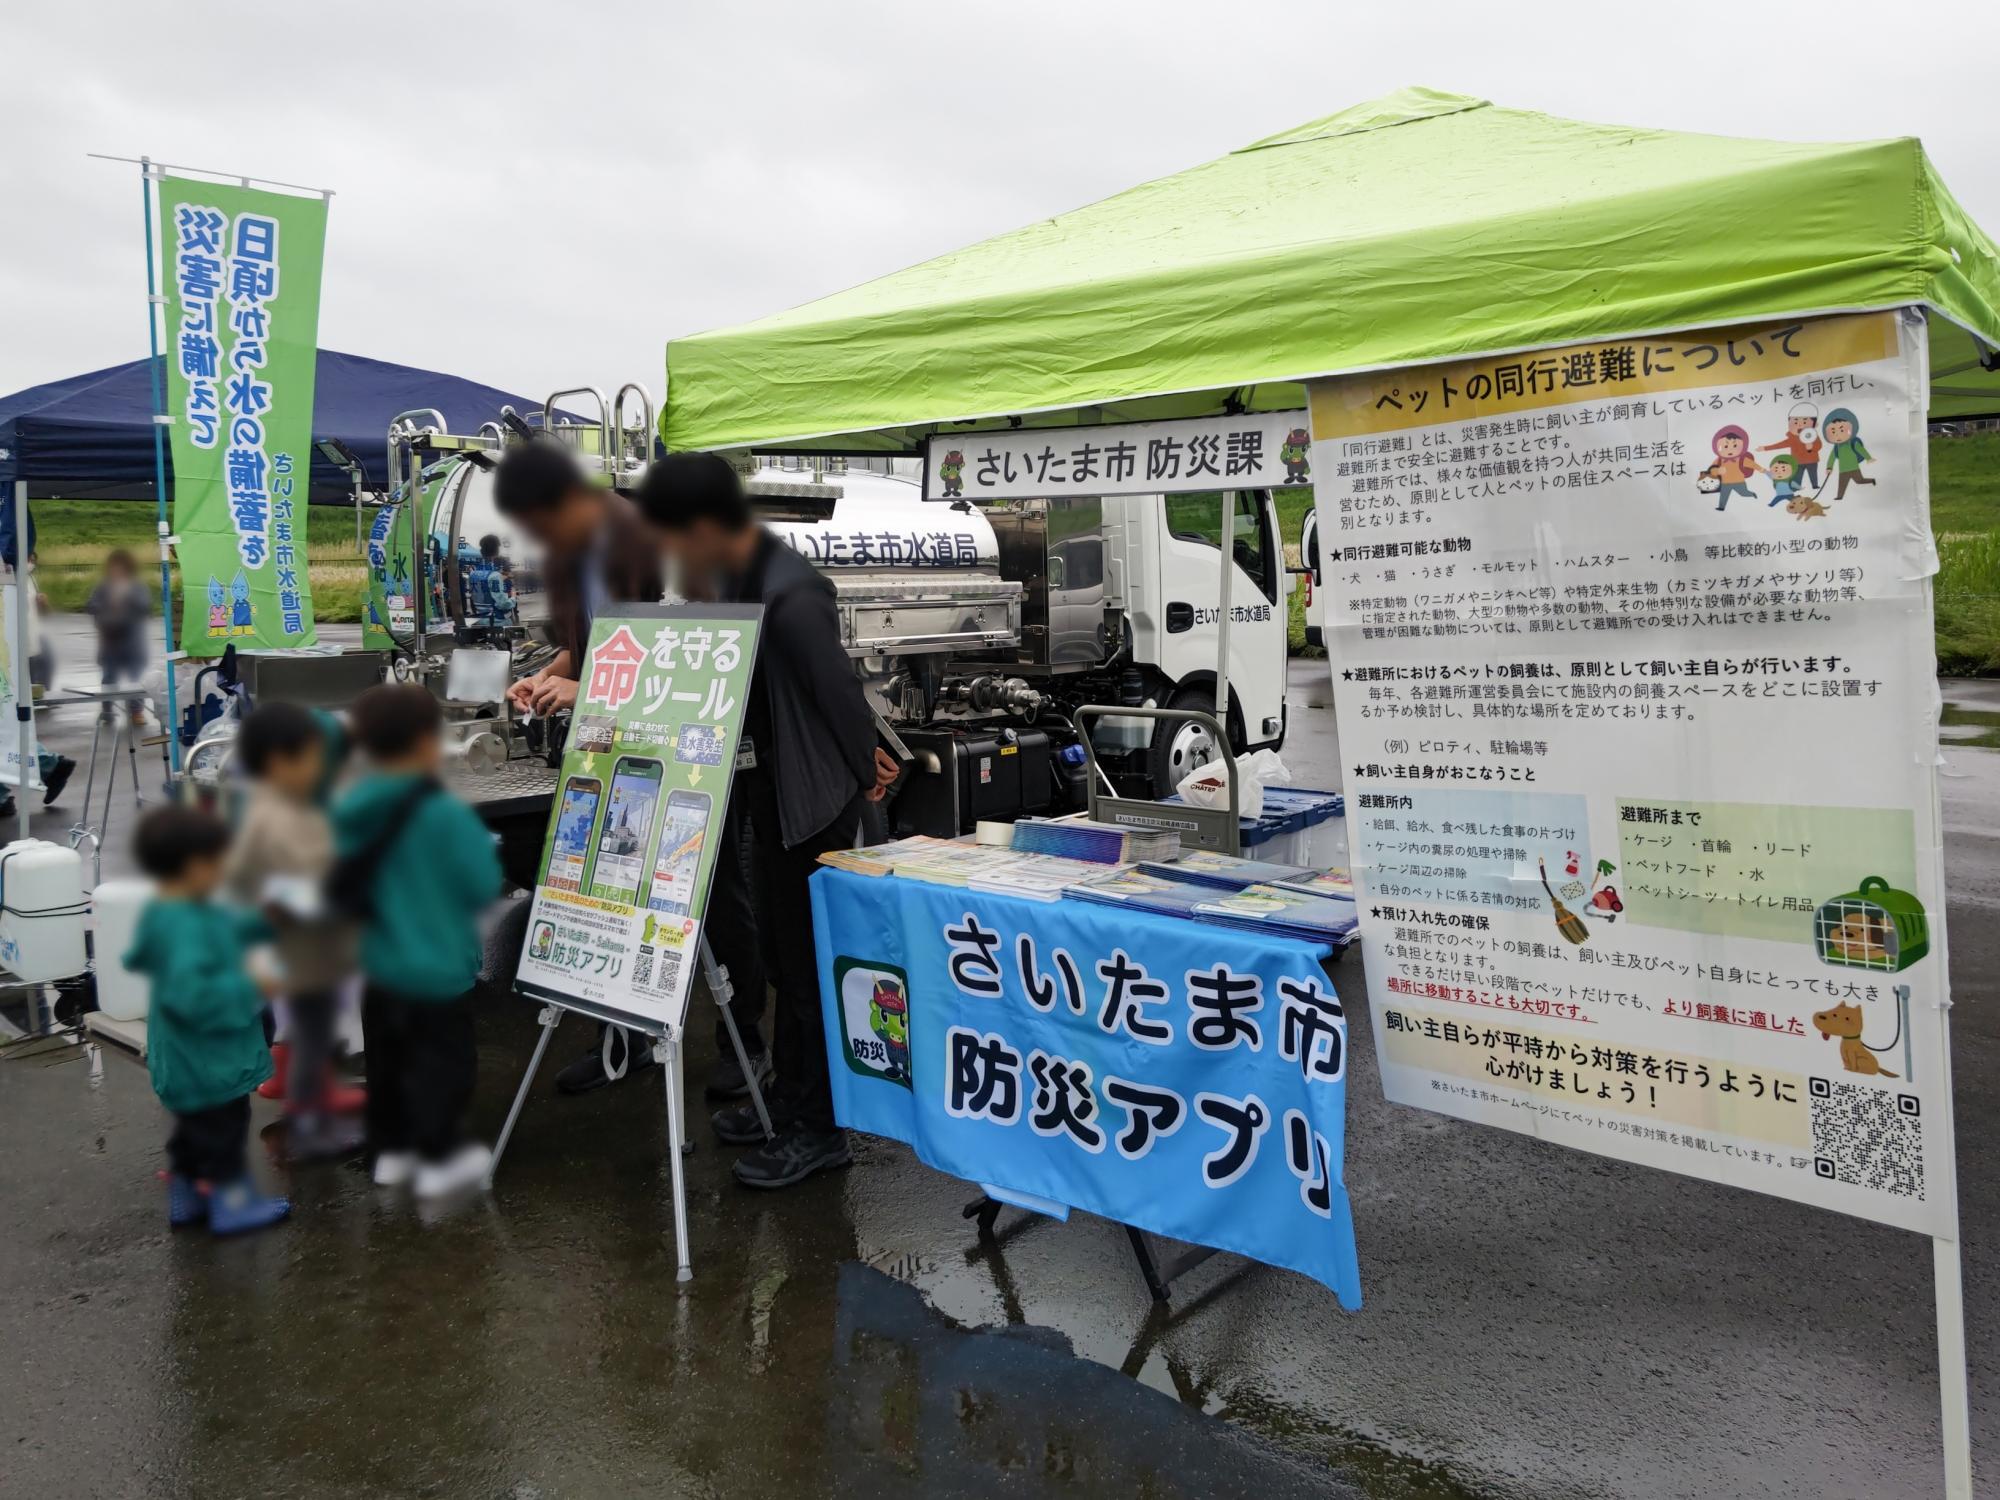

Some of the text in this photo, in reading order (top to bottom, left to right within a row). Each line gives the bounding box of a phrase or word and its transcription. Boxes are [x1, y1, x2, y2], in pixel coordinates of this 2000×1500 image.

[1375, 325, 1804, 413] ペットの同行避難について
[1342, 374, 1876, 457] 「同行避難」とは、災害発生時に飼い主が飼育しているペットを同行し、
[976, 430, 1264, 486] さいたま市 防災課
[1336, 434, 1570, 477] 避難所まで安全に避難することです。
[1352, 440, 1685, 493] 避難所では、様々な価値観を持つ人が共同生活を
[1339, 461, 1686, 512] 営むため、原則として人とペットの居住スペースは
[1340, 508, 1432, 530] 別となります。
[781, 530, 978, 567] いたま市水道局
[1704, 534, 1859, 560] 等比較的小型の動物
[1361, 585, 1865, 625] に指定された動物、大型の動物や多数の動物、その他特別な設備が必要な動物等、
[1362, 608, 1832, 639] 管理が困難な動物については、原則として避難所での受け入れはできません。
[642, 675, 735, 720] ツール
[1368, 679, 1882, 701] 毎年、各避難所運営委員会にて施設内の飼養スペースをどこに設置す
[1360, 702, 1695, 720] るか予め検討し、具体的な場所を定めております。
[1383, 738, 1549, 756] （例）ピロティ、駐輪場等
[1358, 794, 1413, 810] 避難所内
[1620, 806, 1702, 827] 避難所まで
[553, 942, 622, 978] 防災アプリ
[1384, 944, 1496, 971] な負担となります。
[1394, 927, 1879, 1002] 避難所でのペットの飼養は、飼い主及びペット自身にとっても大き
[945, 915, 1344, 1080] さいたま市
[1387, 976, 1592, 1023] 場所に移動することも大切です。
[853, 1038, 886, 1063] 防災
[1385, 1009, 1797, 1104] 飼い主自らが平時から対策を行うように
[1485, 1056, 1657, 1109] 心がけましょう！
[950, 1030, 1332, 1211] 防災アプリ
